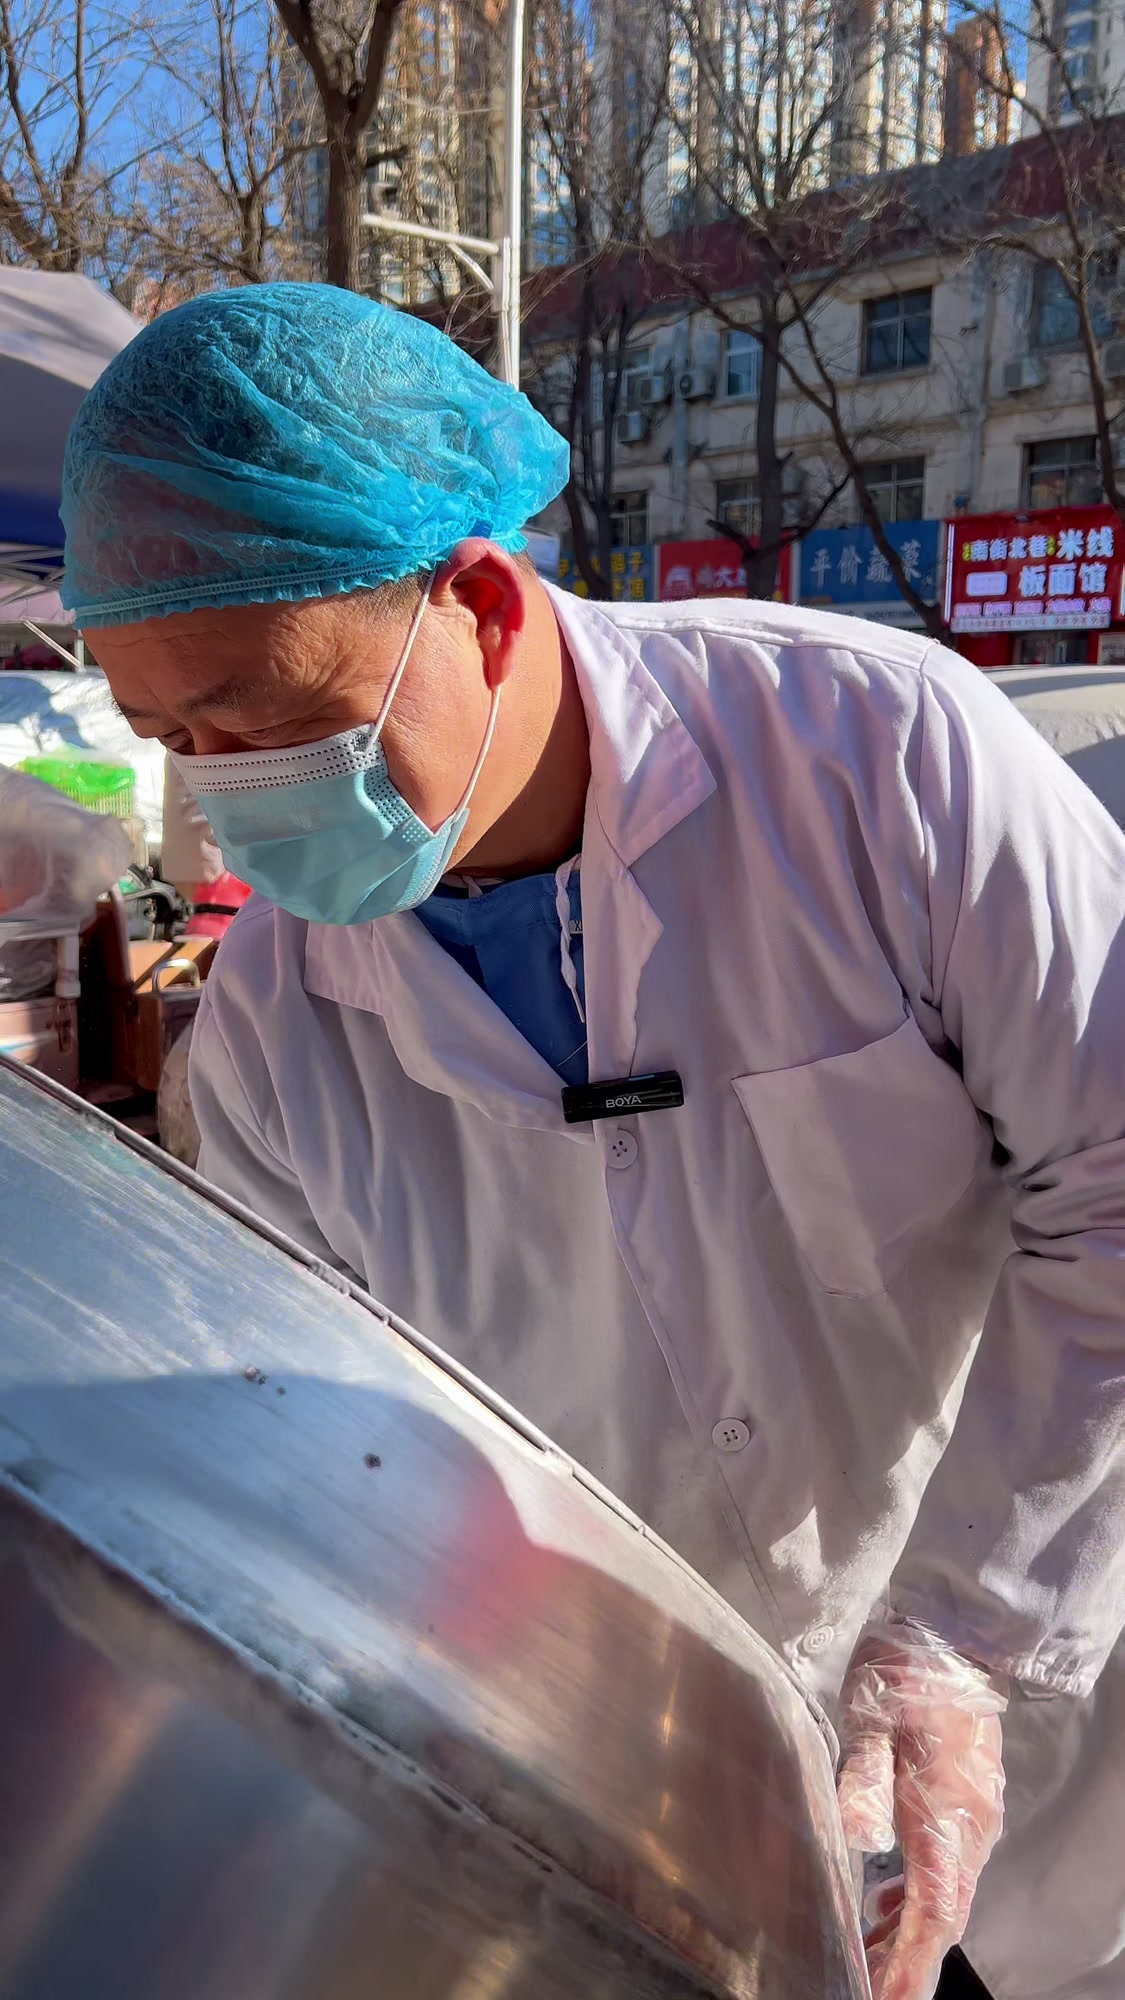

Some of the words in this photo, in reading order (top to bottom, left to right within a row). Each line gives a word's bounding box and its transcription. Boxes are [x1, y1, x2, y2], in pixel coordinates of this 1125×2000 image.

[1056, 526, 1114, 561] 米线
[810, 539, 922, 589] 平价蔬菜
[1018, 561, 1108, 597] 板面馆
[605, 1095, 642, 1108] BOYA
